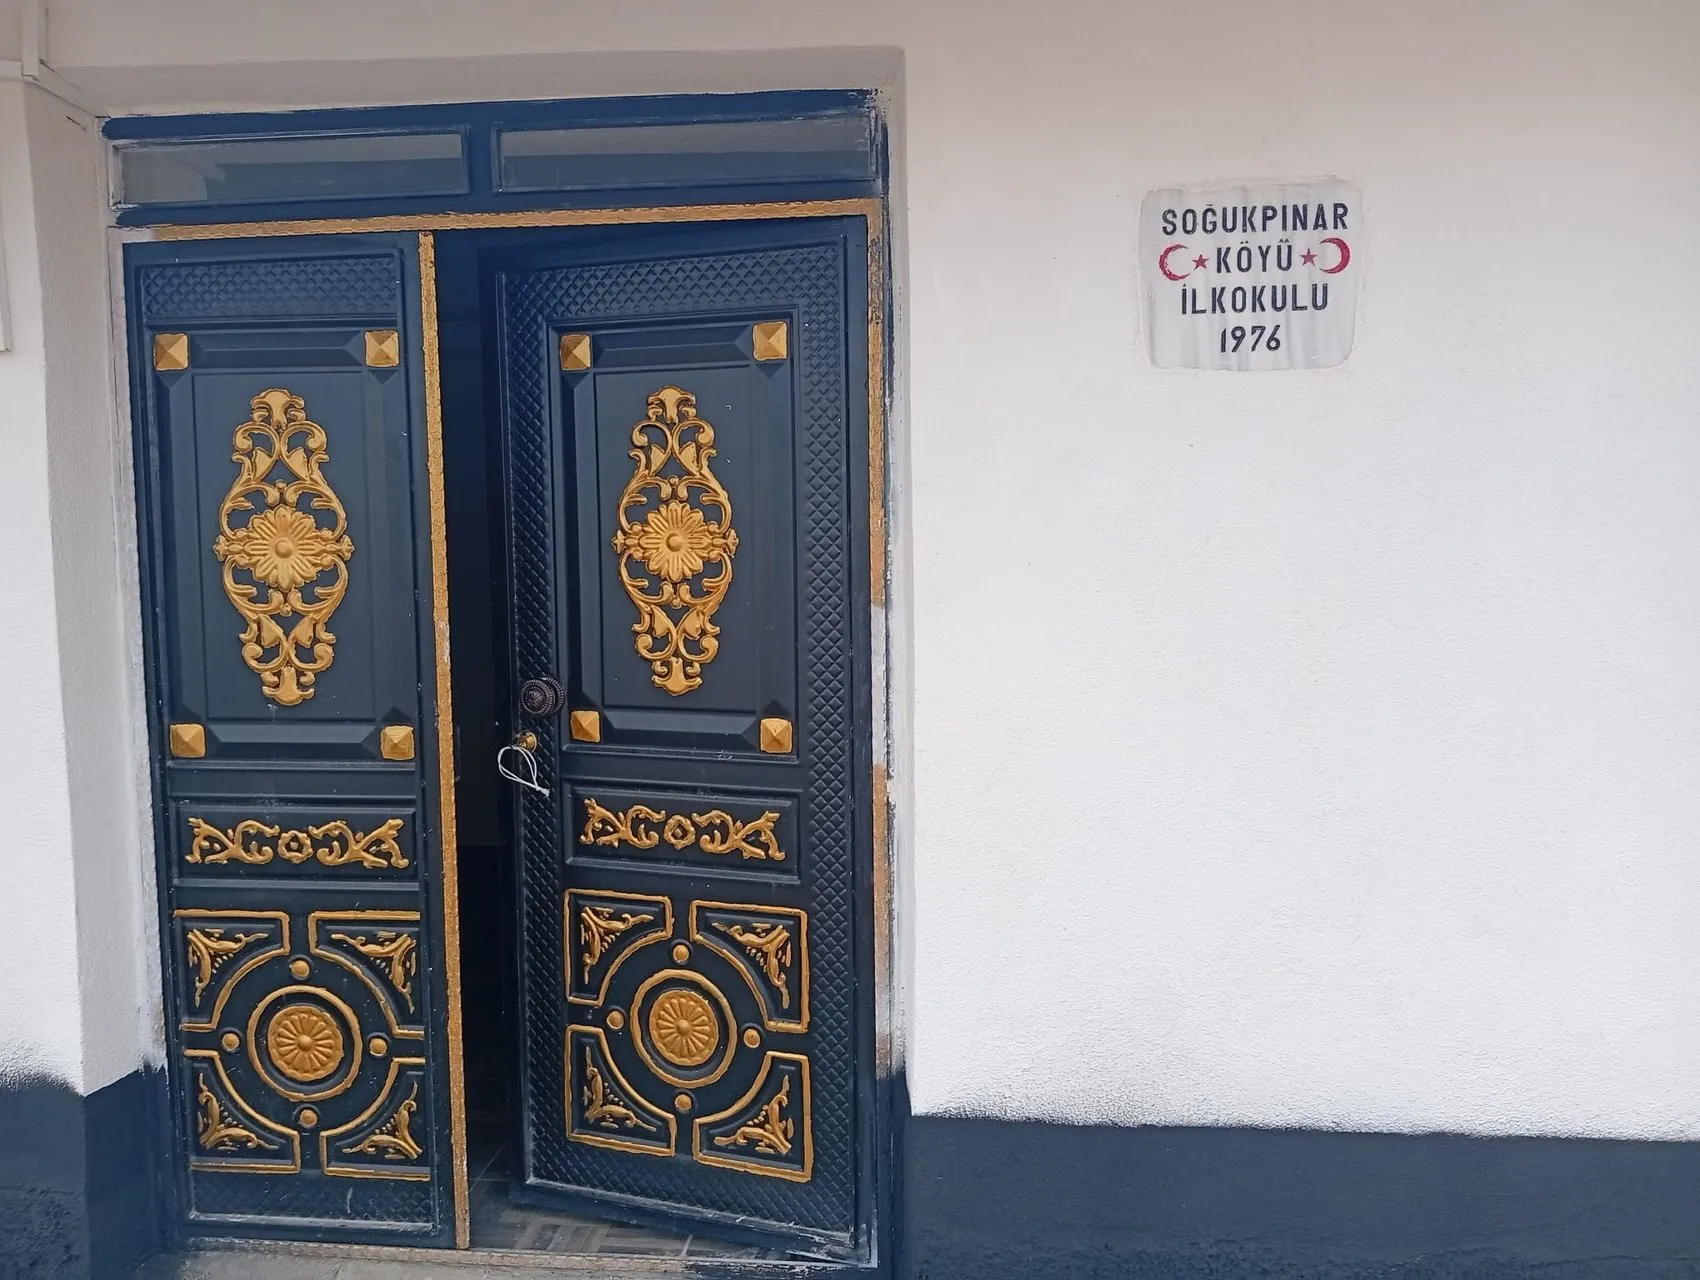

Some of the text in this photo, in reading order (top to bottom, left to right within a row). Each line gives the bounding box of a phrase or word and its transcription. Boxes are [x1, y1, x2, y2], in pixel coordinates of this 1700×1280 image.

[1161, 202, 1349, 236] SOĞUKPINAR
[1216, 238, 1293, 274] KÖYÜ
[1181, 283, 1329, 315] İLKOKULU
[1219, 324, 1282, 353] 1976
